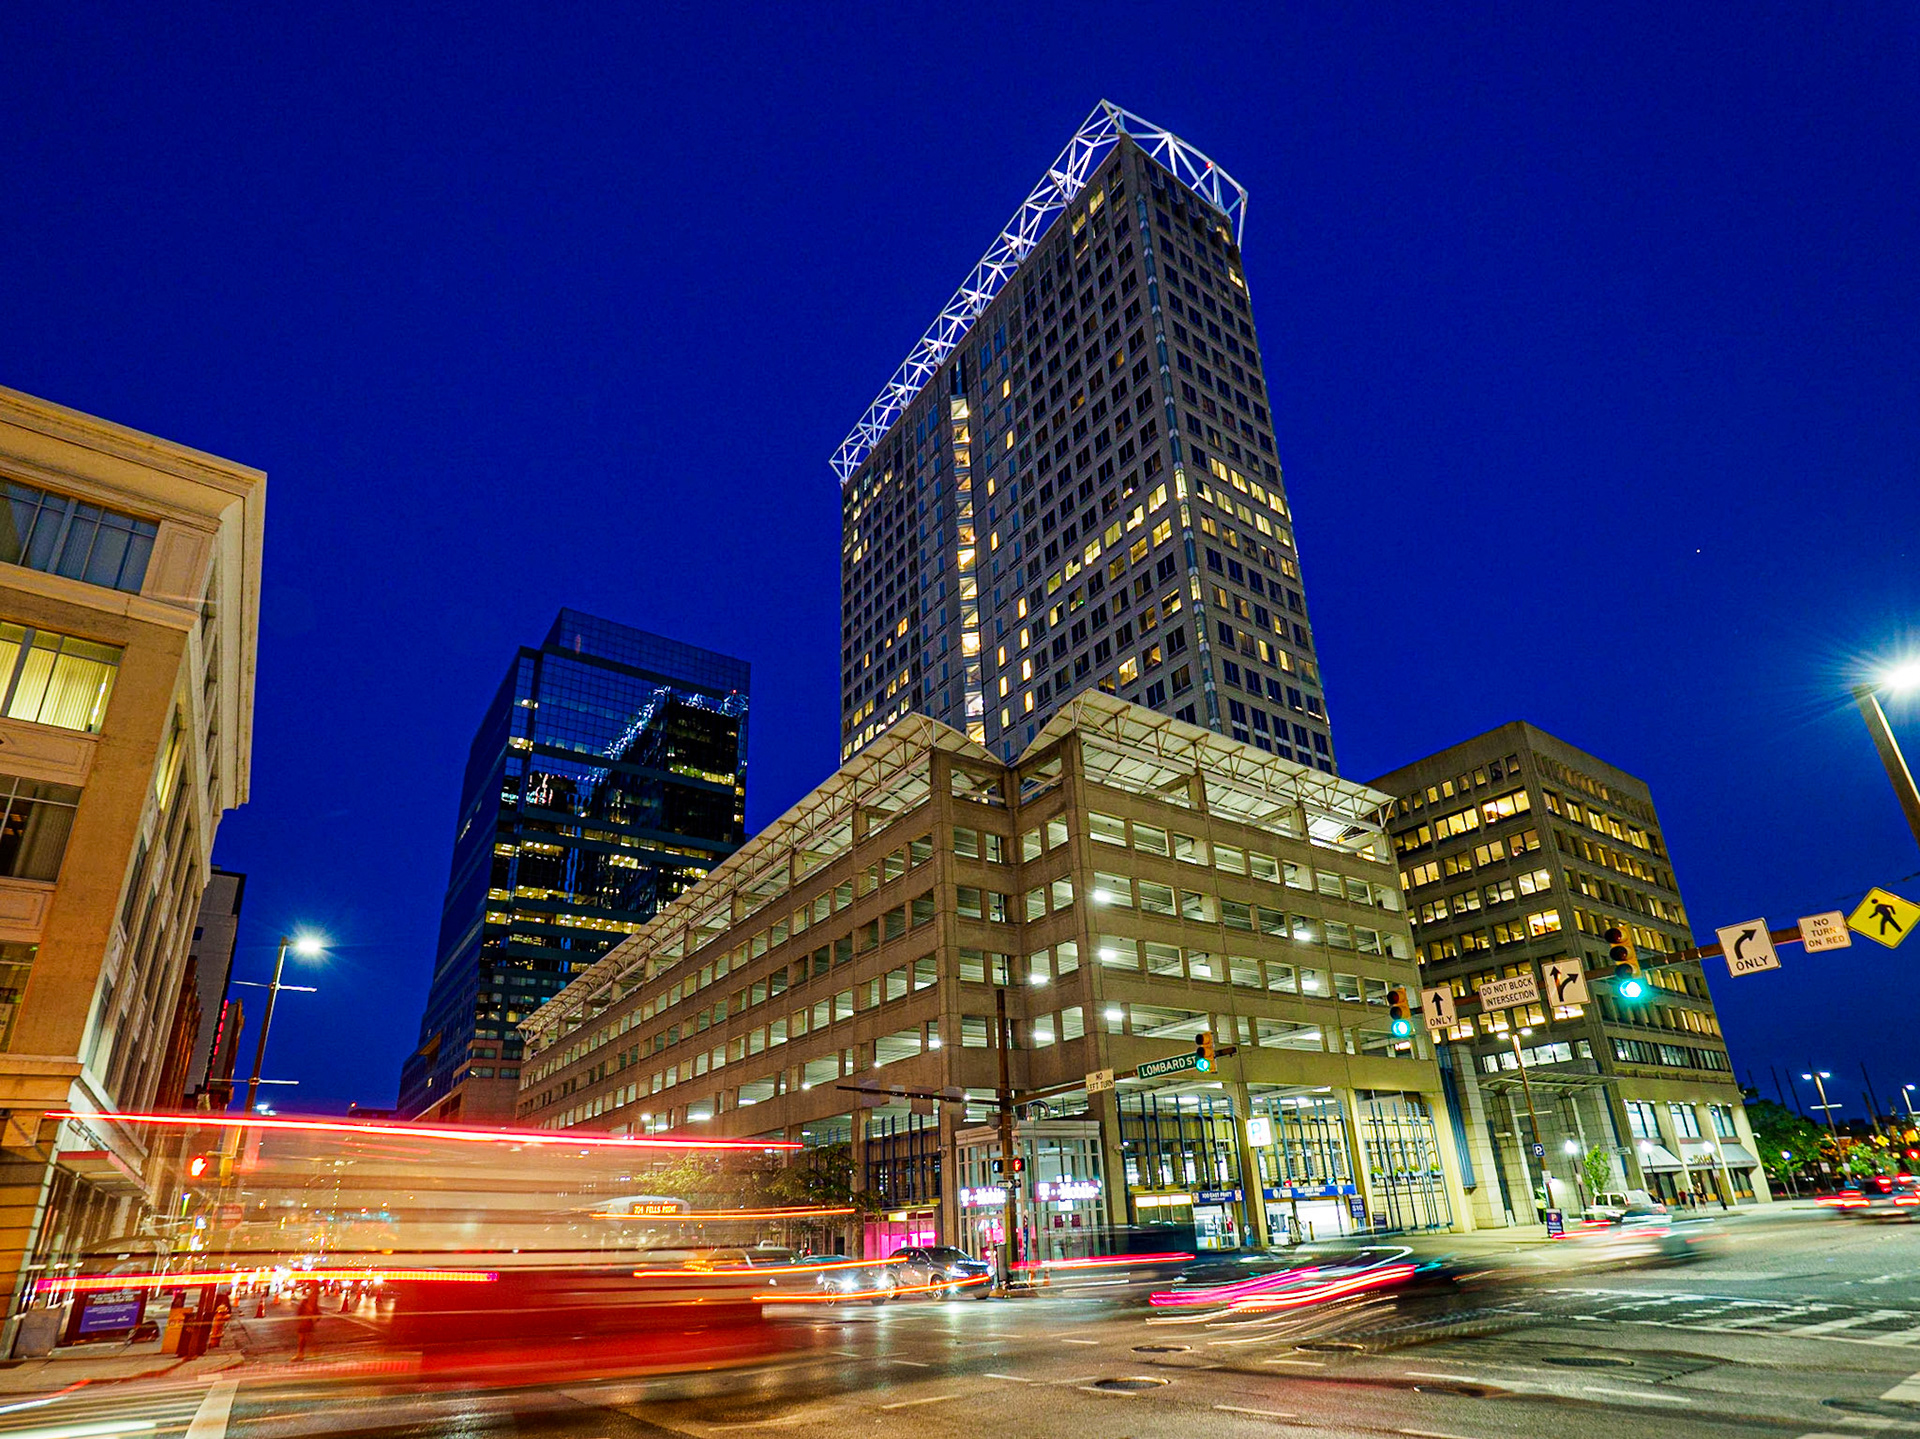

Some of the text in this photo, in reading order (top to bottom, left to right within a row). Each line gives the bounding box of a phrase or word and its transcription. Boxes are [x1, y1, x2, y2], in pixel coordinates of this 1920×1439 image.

[1813, 918, 1829, 927] NO
[1811, 927, 1836, 937] TURN
[1808, 935, 1845, 948] ON RED
[1736, 955, 1768, 971] ONLY
[1482, 978, 1533, 996] DO NOT BLOCK
[1486, 990, 1535, 1007] INTERSECTION
[1430, 1016, 1453, 1026] ONLY
[1142, 1056, 1196, 1077] LOMBARD ST
[1096, 1072, 1104, 1080] NO
[1088, 1079, 1113, 1092] LEFT TURN
